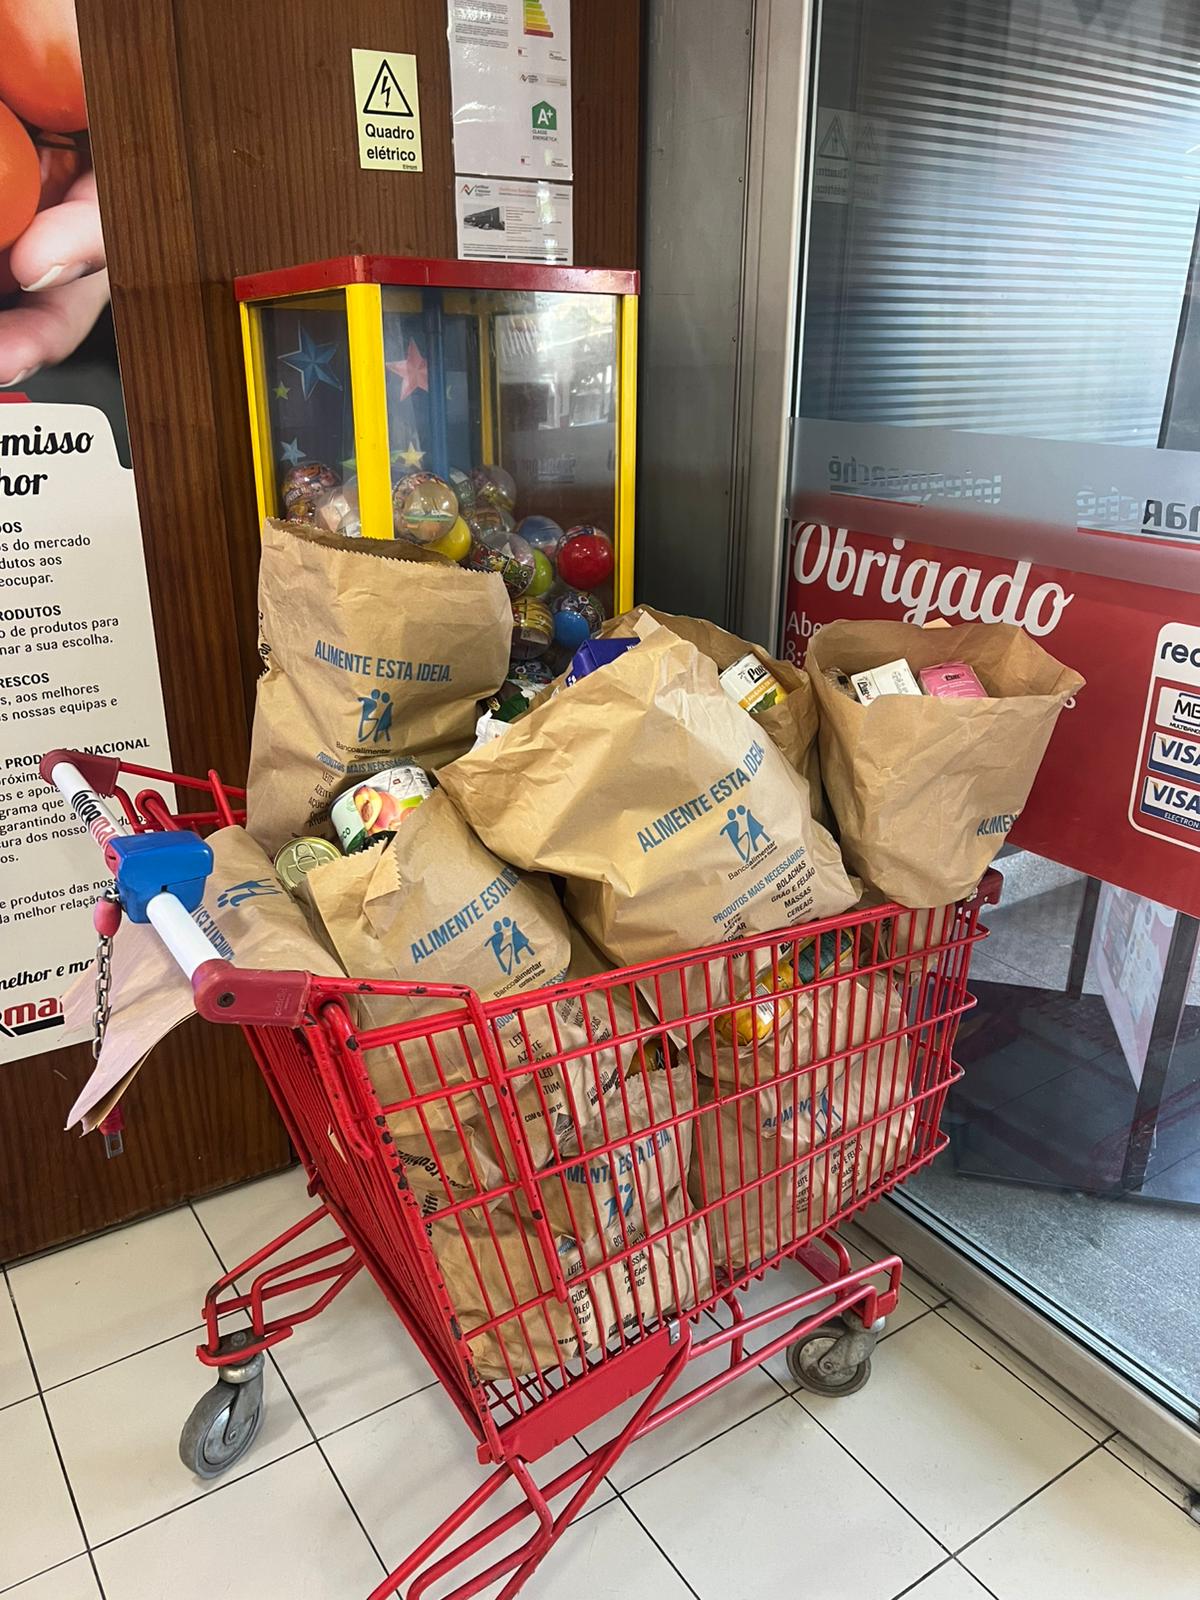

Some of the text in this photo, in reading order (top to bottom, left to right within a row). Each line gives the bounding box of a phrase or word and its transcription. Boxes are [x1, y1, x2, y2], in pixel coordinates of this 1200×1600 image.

[365, 123, 415, 141] Quadro
[366, 145, 416, 162] elétrico
[0, 521, 23, 534] OS
[13, 539, 30, 551] do
[34, 534, 91, 550] mercado
[39, 556, 63, 567] aos
[789, 520, 1075, 637] Obrigado
[10, 626, 26, 637] de
[30, 621, 88, 638] produtos
[91, 618, 119, 631] para
[25, 644, 32, 653] a
[36, 641, 58, 652] sua
[62, 633, 113, 648] escolha.
[315, 640, 453, 682] ALIMENTE ESTA IDEIA.
[16, 692, 38, 704] aos
[42, 684, 100, 700] melhores
[12, 706, 56, 720] nossas
[60, 699, 107, 714] equipas
[111, 697, 118, 706] e
[83, 738, 150, 755] NACIONAL
[17, 790, 24, 799] e
[1150, 781, 1200, 816] VISA
[42, 799, 64, 814] que
[637, 794, 713, 853] ALIMENTE
[709, 768, 751, 804] ESTA
[0, 812, 77, 835] garantindo a
[1164, 812, 1200, 829] ELECTRON
[26, 831, 48, 844] dos
[728, 840, 776, 881] Bancoalimentar
[712, 846, 806, 924] PRODUTOS MAIS NECESSÁRIOS
[776, 860, 807, 891] BOLACHAS
[796, 867, 816, 889] FEIJÃO
[10, 889, 65, 908] produtos
[69, 884, 89, 895] das
[784, 886, 812, 908] MASSAS
[14, 903, 56, 921] melhor
[787, 896, 814, 918] CEREAIS
[411, 900, 484, 964] ALIMENTE
[480, 877, 512, 912] ESTA
[57, 966, 65, 977] e
[493, 961, 542, 998] Bancoalimentar
[543, 1081, 561, 1095] TUM
[619, 1146, 647, 1176] ESA
